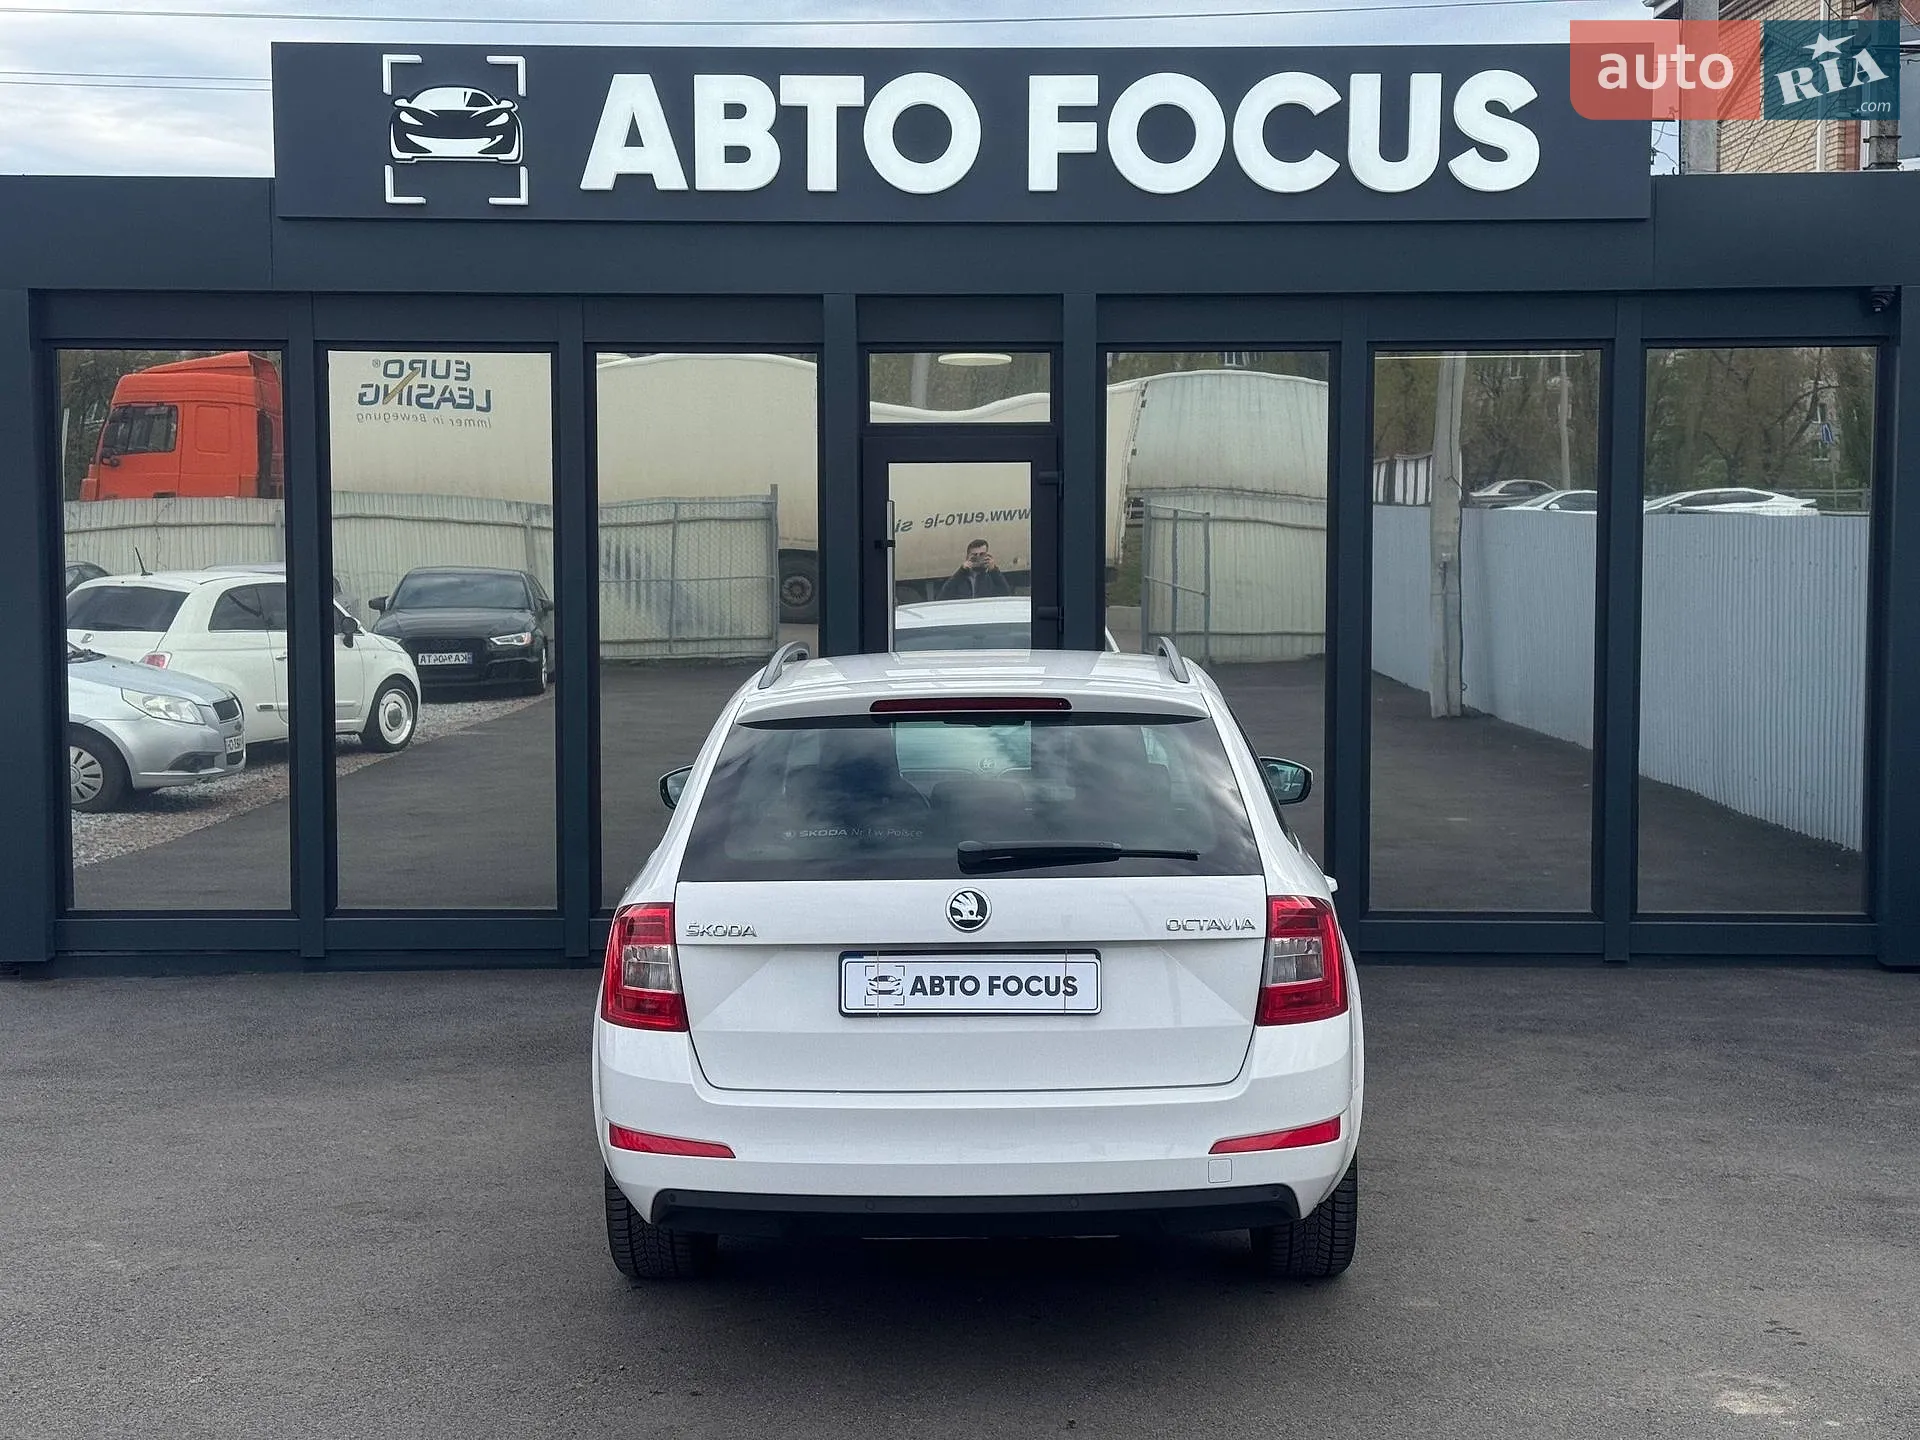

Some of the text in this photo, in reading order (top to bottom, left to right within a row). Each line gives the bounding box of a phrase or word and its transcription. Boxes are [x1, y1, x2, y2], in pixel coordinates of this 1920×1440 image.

[580, 69, 1540, 195] АВТО FOCUS
[1166, 918, 1256, 931] OCTAVIA
[909, 975, 1079, 997] АВТО FOCUS
